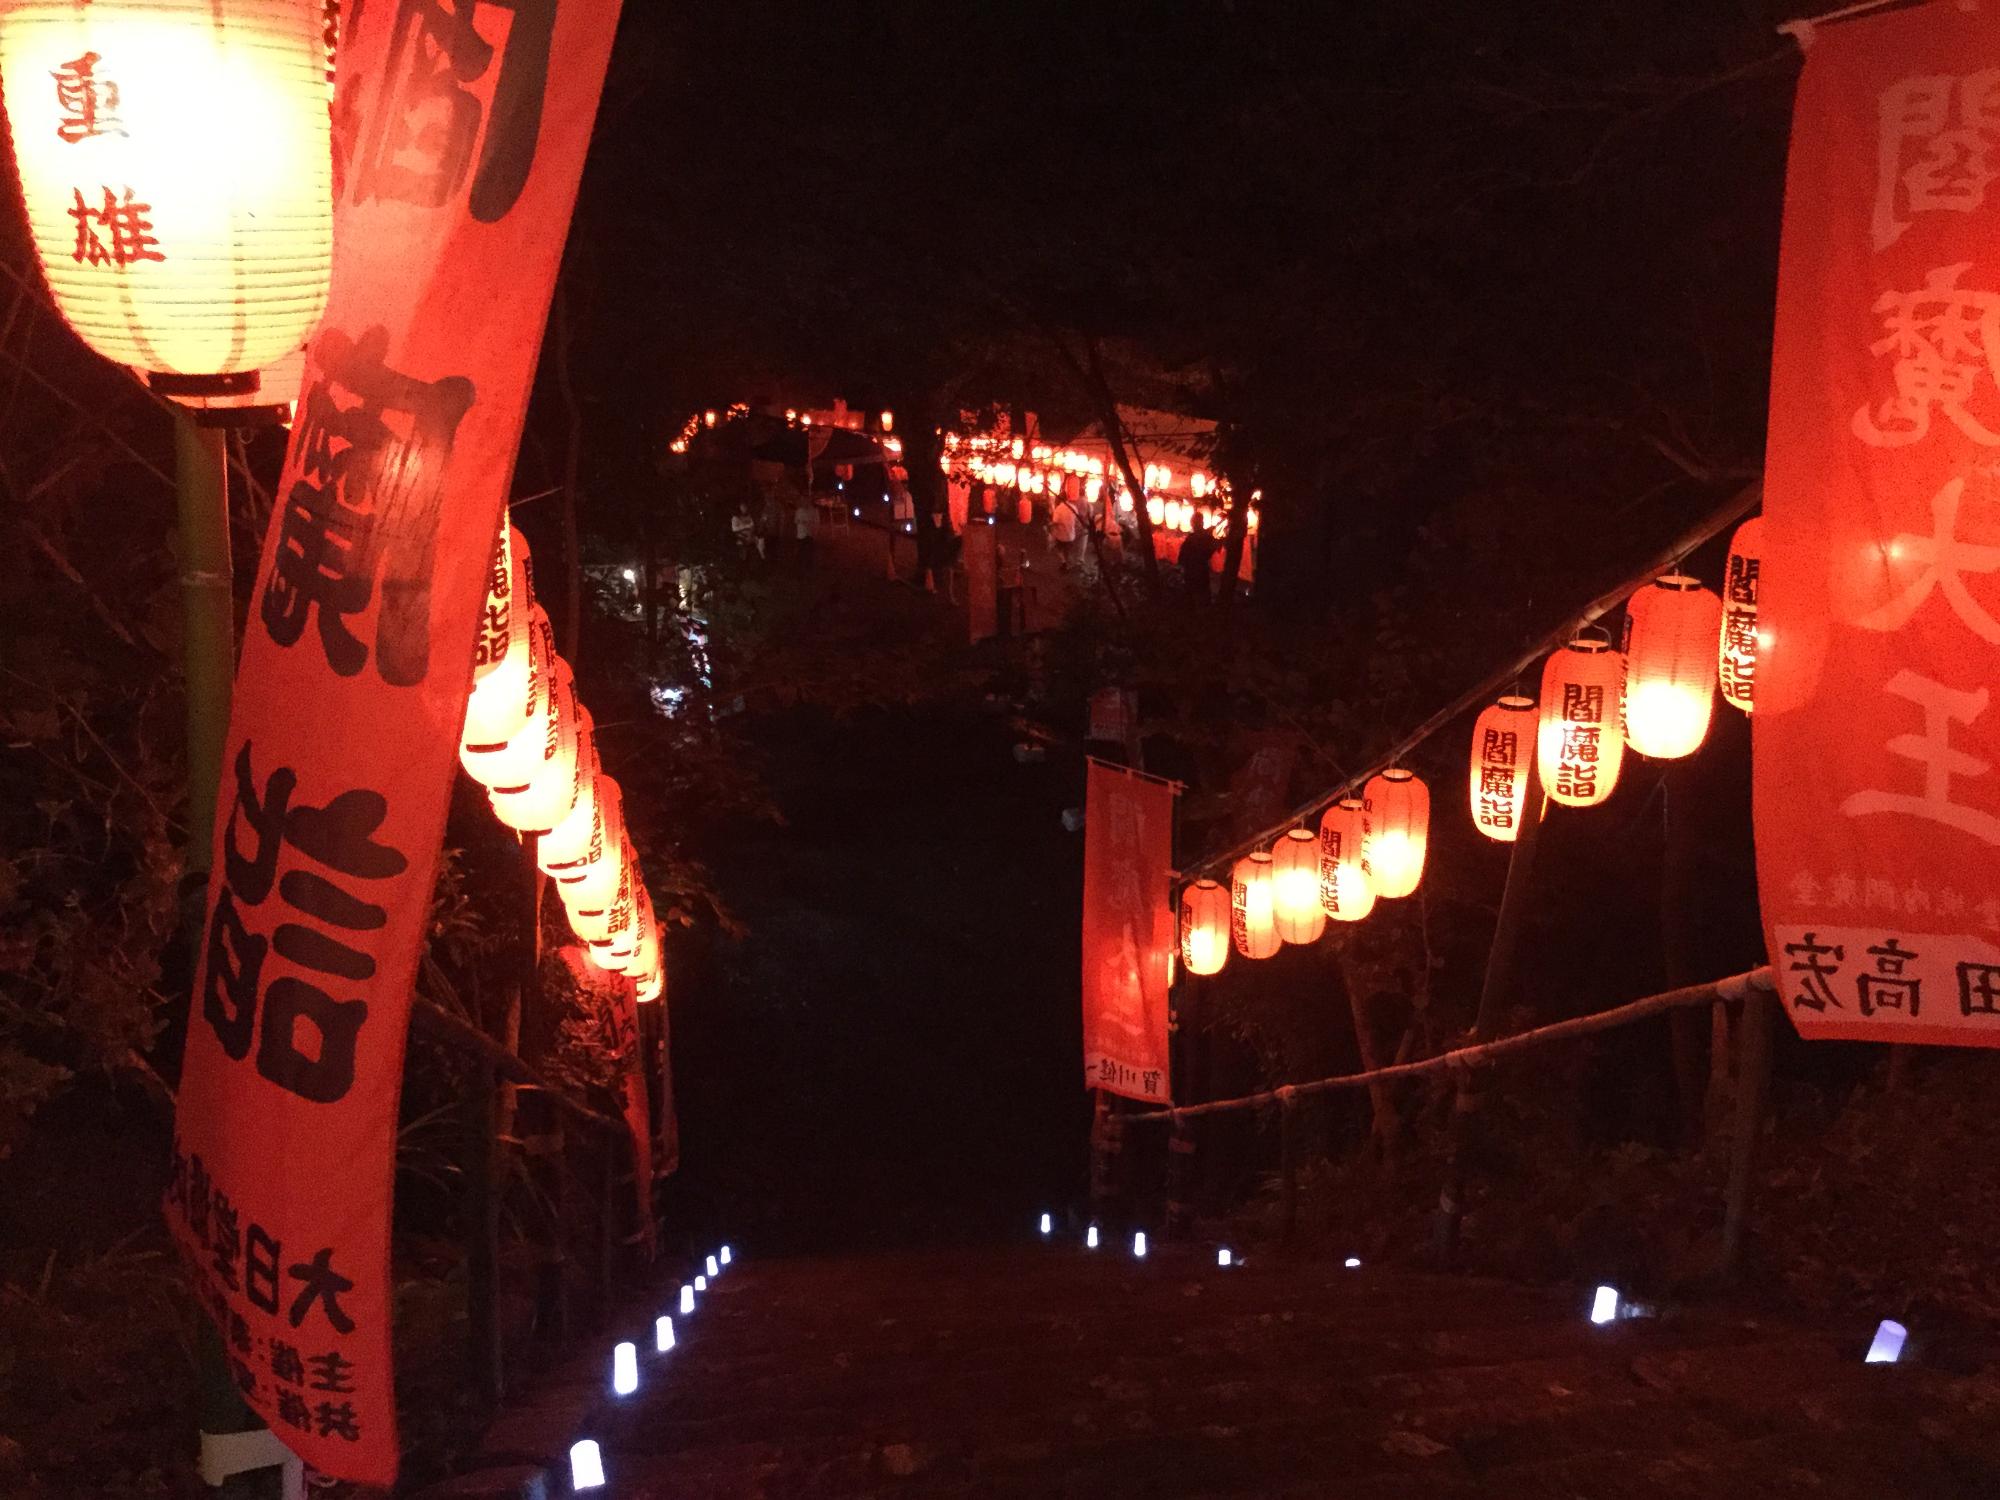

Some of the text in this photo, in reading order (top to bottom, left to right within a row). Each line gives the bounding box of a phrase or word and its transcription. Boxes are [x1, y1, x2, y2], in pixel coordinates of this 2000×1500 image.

[1480, 728, 1517, 828] 閻魔詣
[1556, 683, 1604, 798] 閻魔詣
